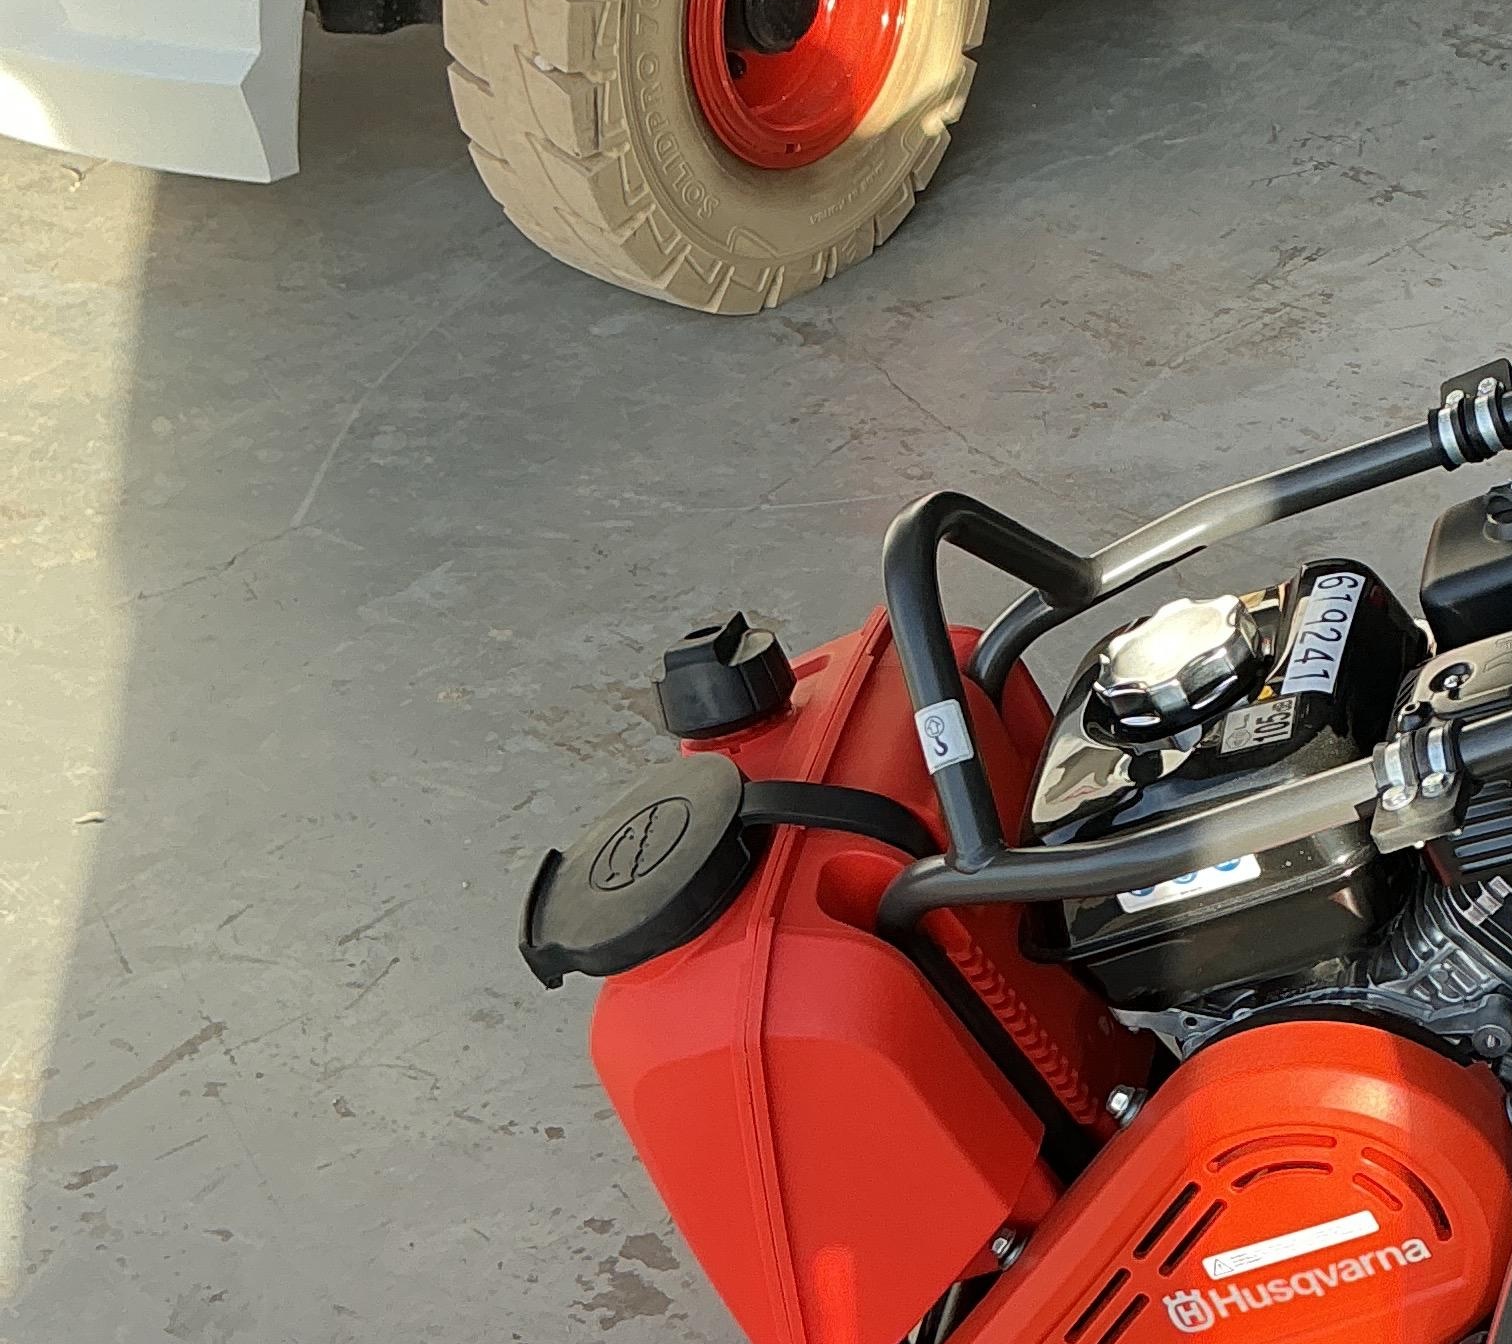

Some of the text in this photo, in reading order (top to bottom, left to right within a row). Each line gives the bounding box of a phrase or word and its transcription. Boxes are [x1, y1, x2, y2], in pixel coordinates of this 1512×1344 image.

[634, 49, 721, 220] SOLIDPRO
[1288, 575, 1359, 681] 619241
[1253, 712, 1291, 743] 105
[1207, 1238, 1433, 1319] Husqvarna
